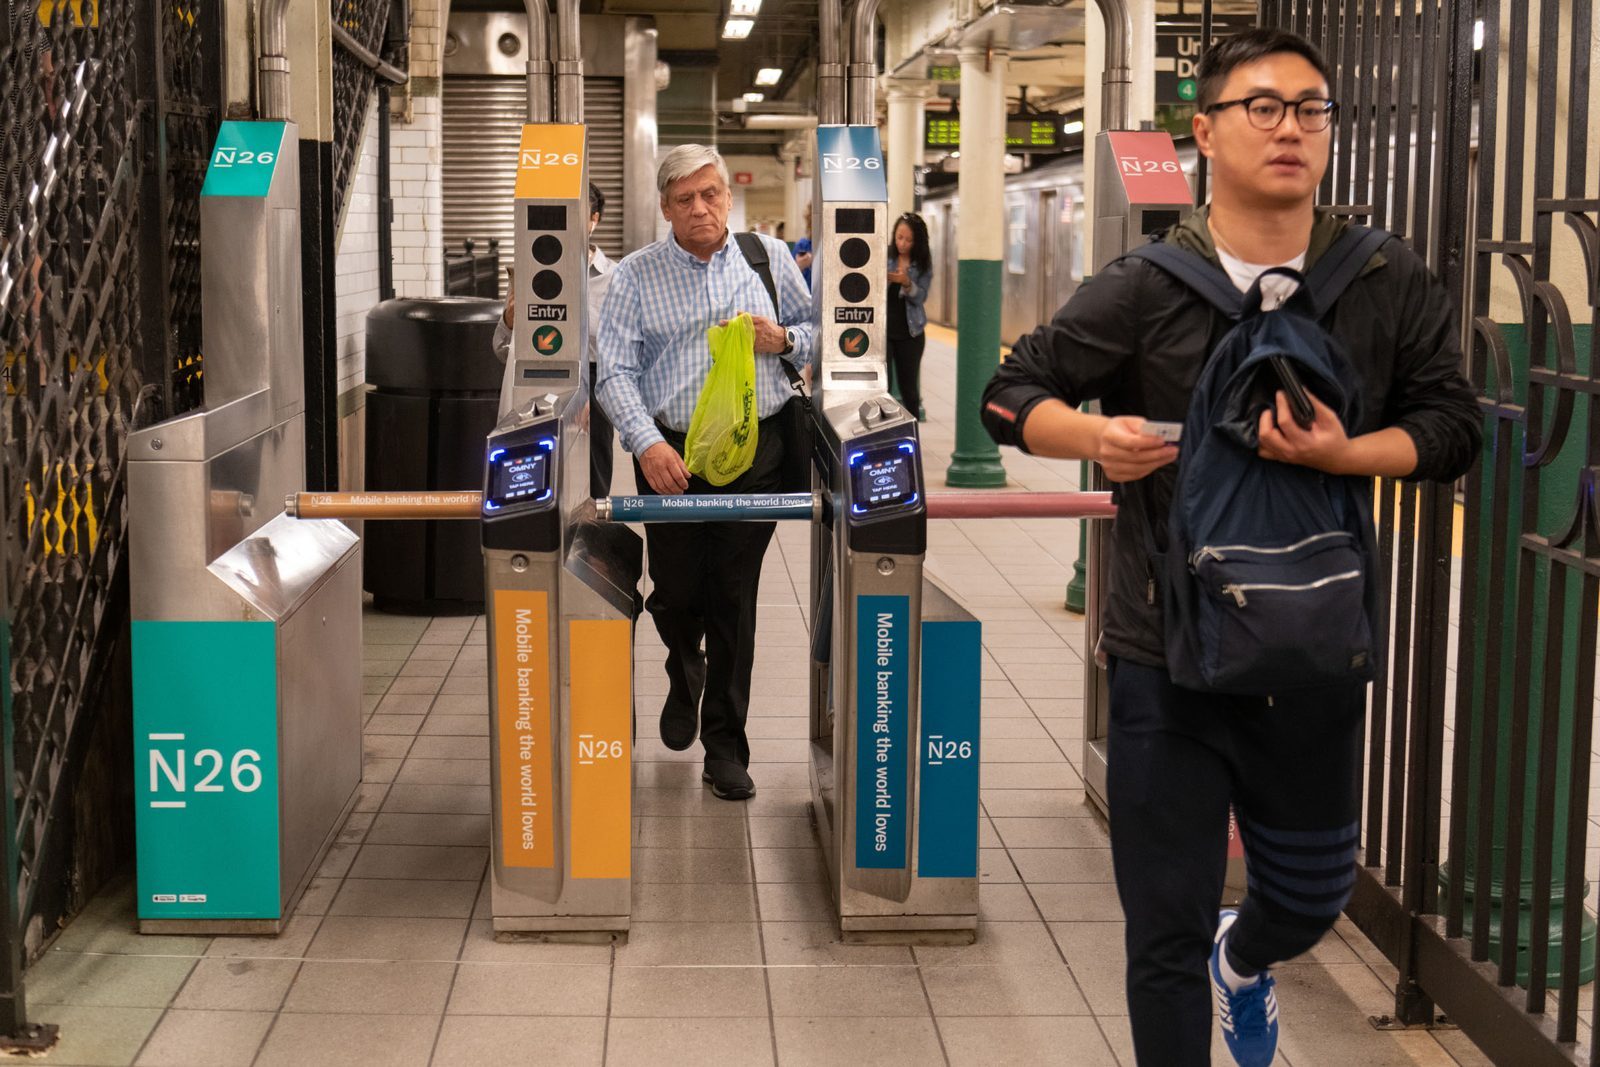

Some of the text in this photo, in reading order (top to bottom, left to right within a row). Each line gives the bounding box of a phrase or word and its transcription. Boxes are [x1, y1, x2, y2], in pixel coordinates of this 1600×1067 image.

[1182, 84, 1193, 96] 4
[213, 147, 274, 168] N26
[521, 149, 579, 169] N26
[823, 153, 880, 173] N26
[1120, 156, 1179, 176] N26
[528, 305, 566, 321] Entry
[836, 308, 872, 323] Entry
[509, 462, 536, 473] OMNY
[869, 466, 896, 476] OMNY
[350, 495, 382, 505] Mobile
[385, 495, 422, 506] banking
[424, 495, 440, 504] the
[442, 494, 469, 504] world
[623, 497, 806, 511] N26 Mobile banking the world loves
[515, 609, 537, 850] Mobile banking the world loves
[872, 613, 893, 852] Mobile banking the world loves
[578, 734, 623, 765] N26
[928, 735, 972, 765] N26
[147, 733, 262, 808] N26
